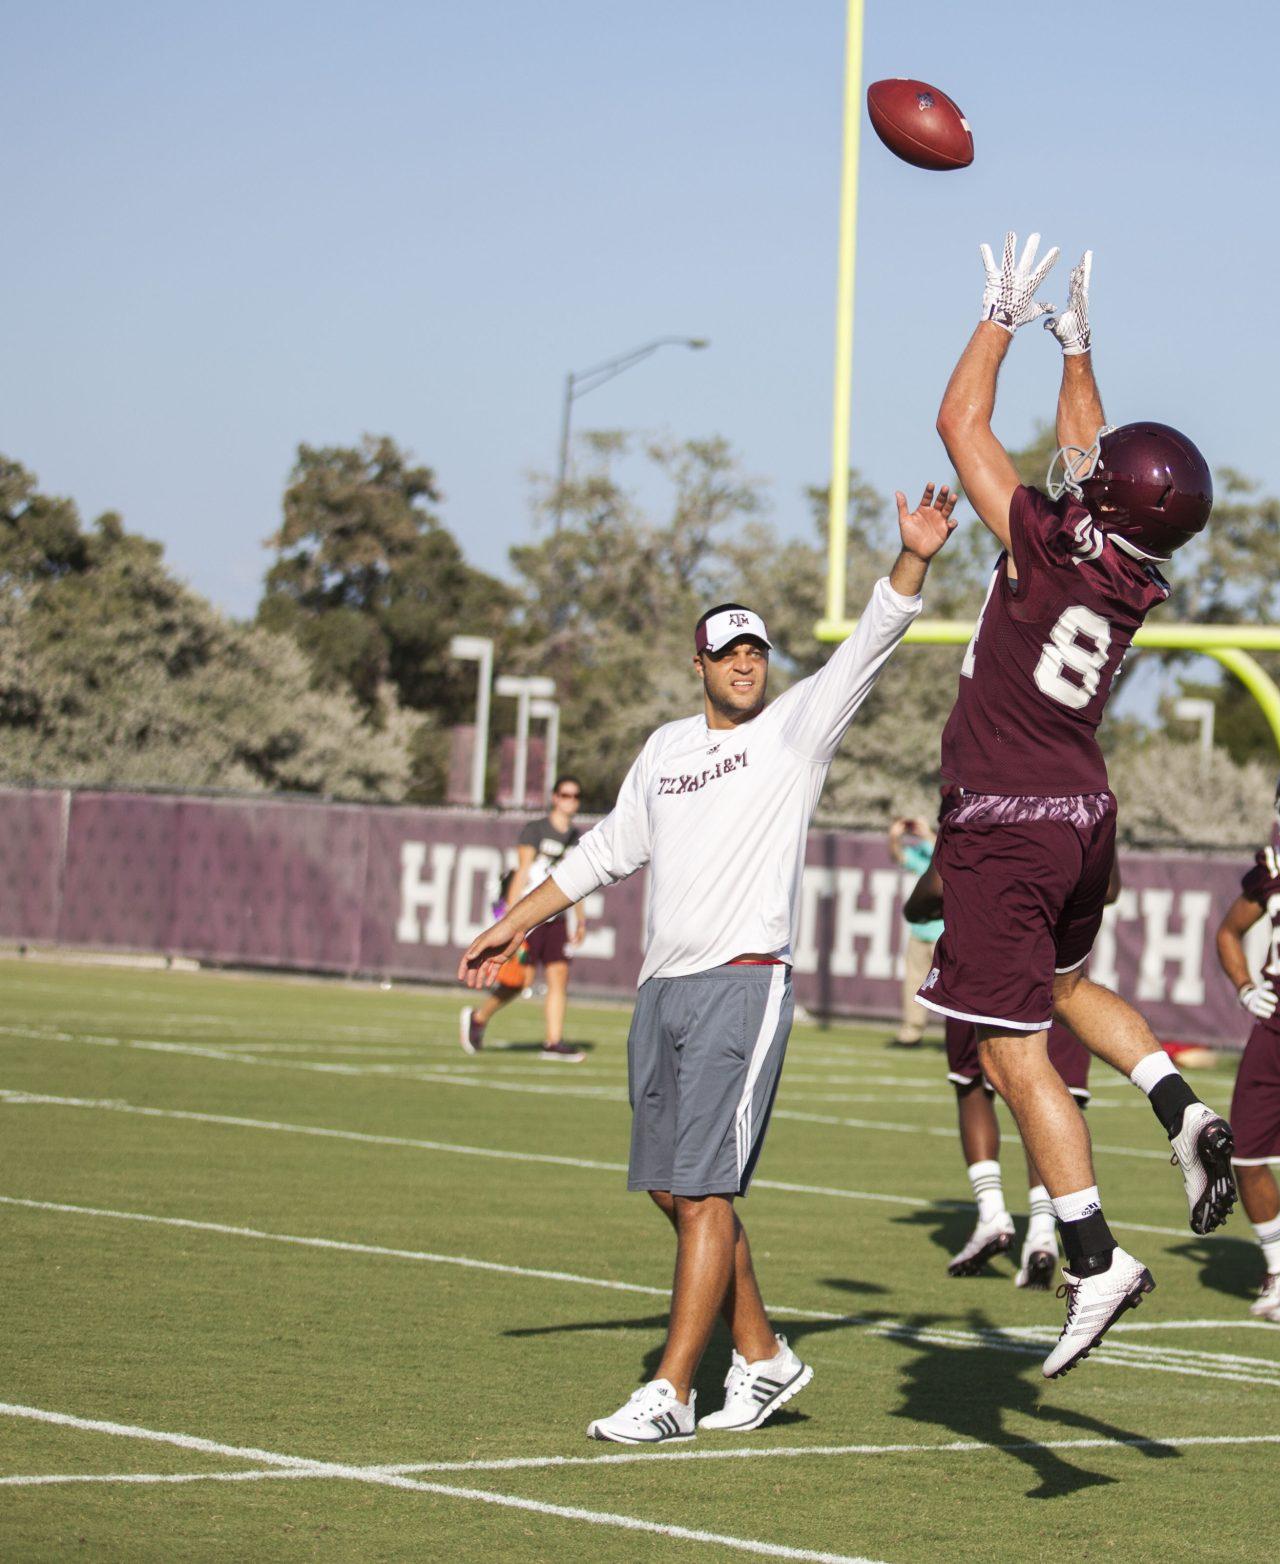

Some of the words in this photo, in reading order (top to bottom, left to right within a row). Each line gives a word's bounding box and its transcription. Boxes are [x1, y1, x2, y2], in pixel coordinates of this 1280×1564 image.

[1033, 604, 1122, 710] 8
[792, 864, 916, 980] TH
[1088, 888, 1212, 1006] TH
